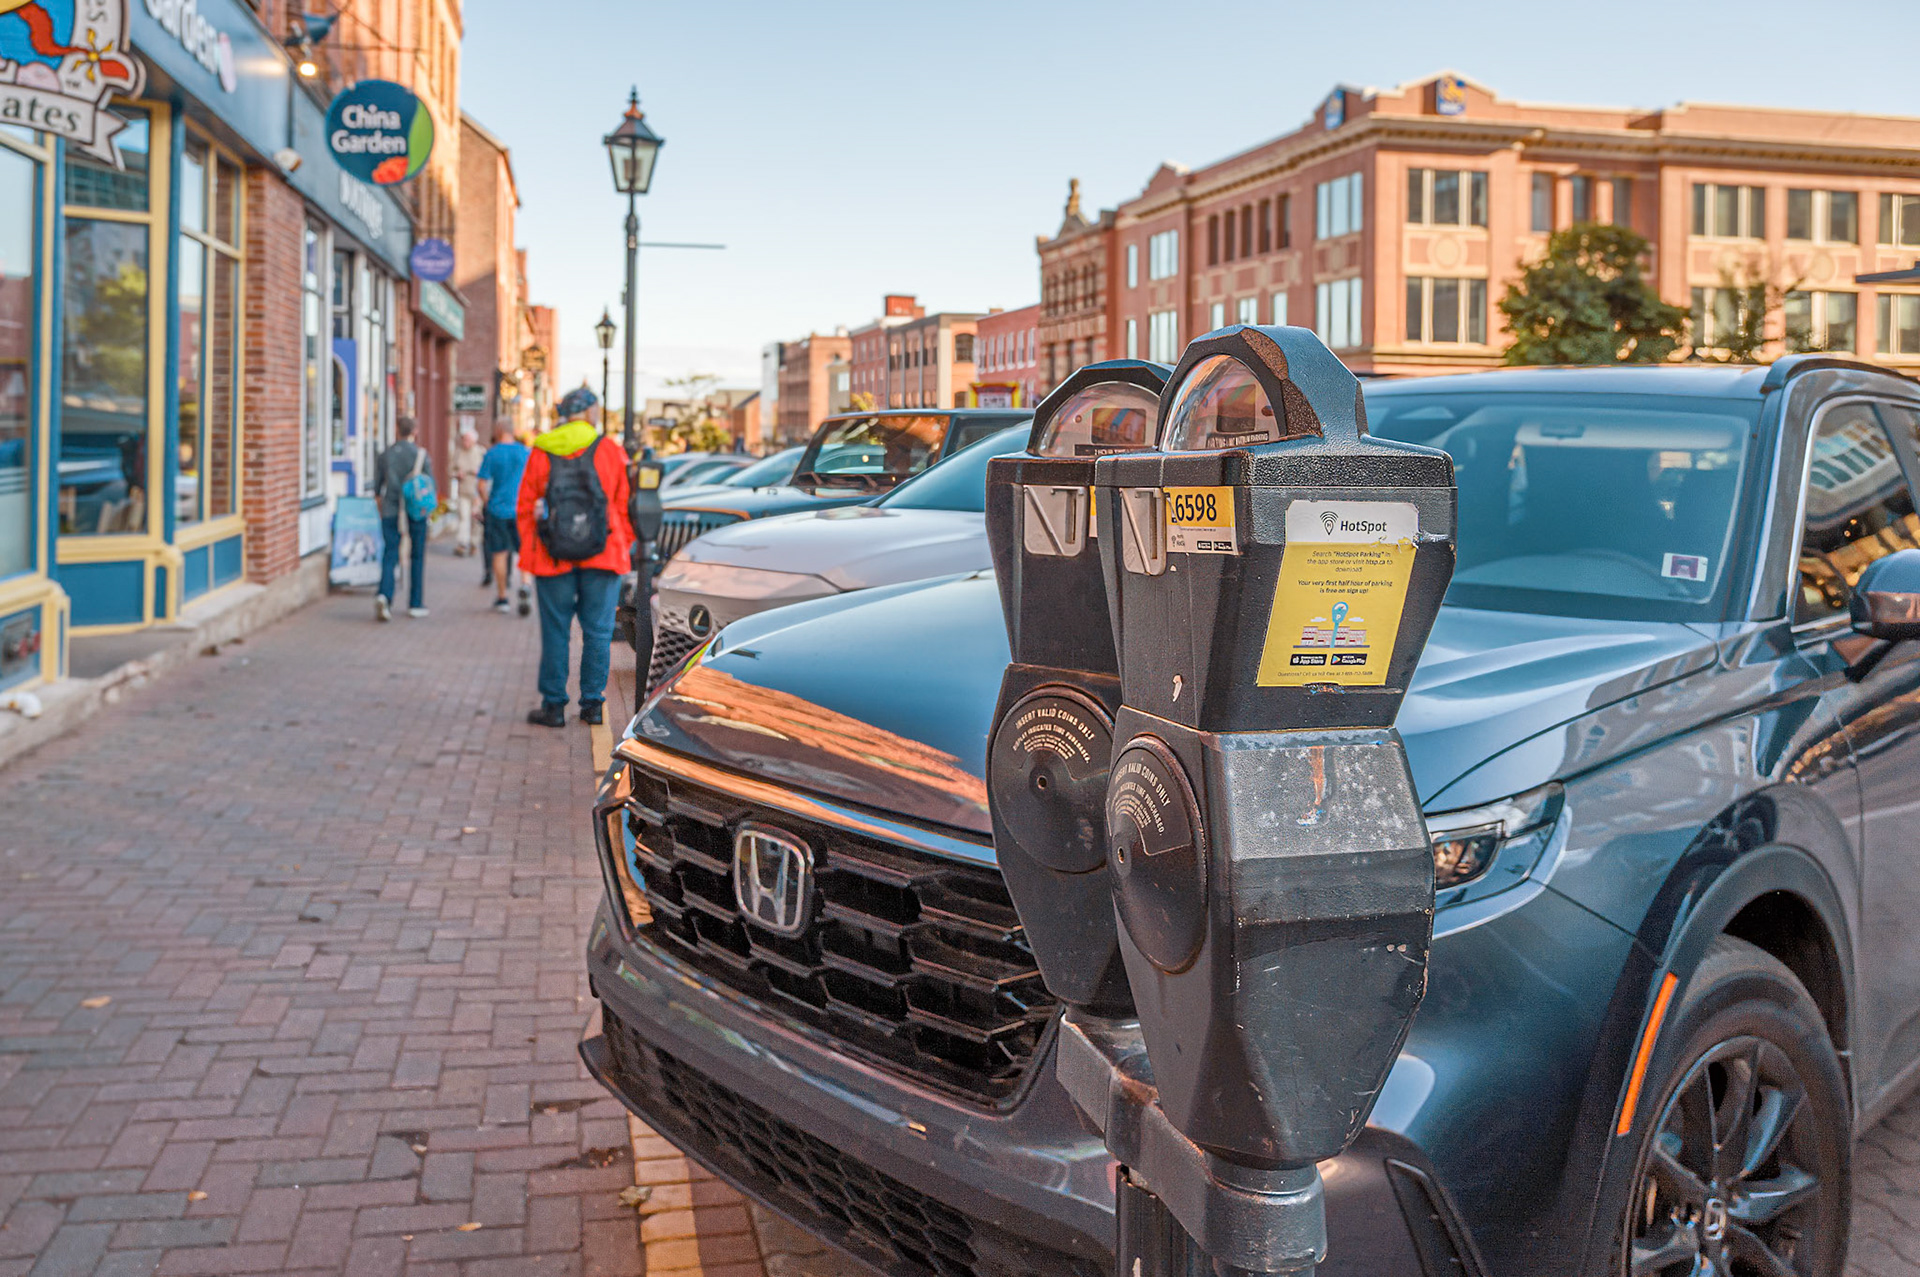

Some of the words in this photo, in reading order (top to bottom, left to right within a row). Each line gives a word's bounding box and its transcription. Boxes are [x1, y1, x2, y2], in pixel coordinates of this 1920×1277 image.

[341, 104, 402, 130] China
[331, 130, 407, 154] Garden
[1175, 493, 1217, 521] 6598
[1340, 520, 1387, 534] HotSpot
[1333, 550, 1359, 558] "HotSpot
[1360, 551, 1385, 559] Parking"
[1015, 710, 1036, 730] INSERT
[1037, 708, 1057, 718] VALID
[1057, 709, 1078, 726] COINS
[1078, 722, 1095, 741] ONLY
[1128, 762, 1142, 774] VALID
[1141, 765, 1159, 787] COINS
[1155, 783, 1171, 807] ONLY
[1144, 793, 1165, 836] PURCHASED.
